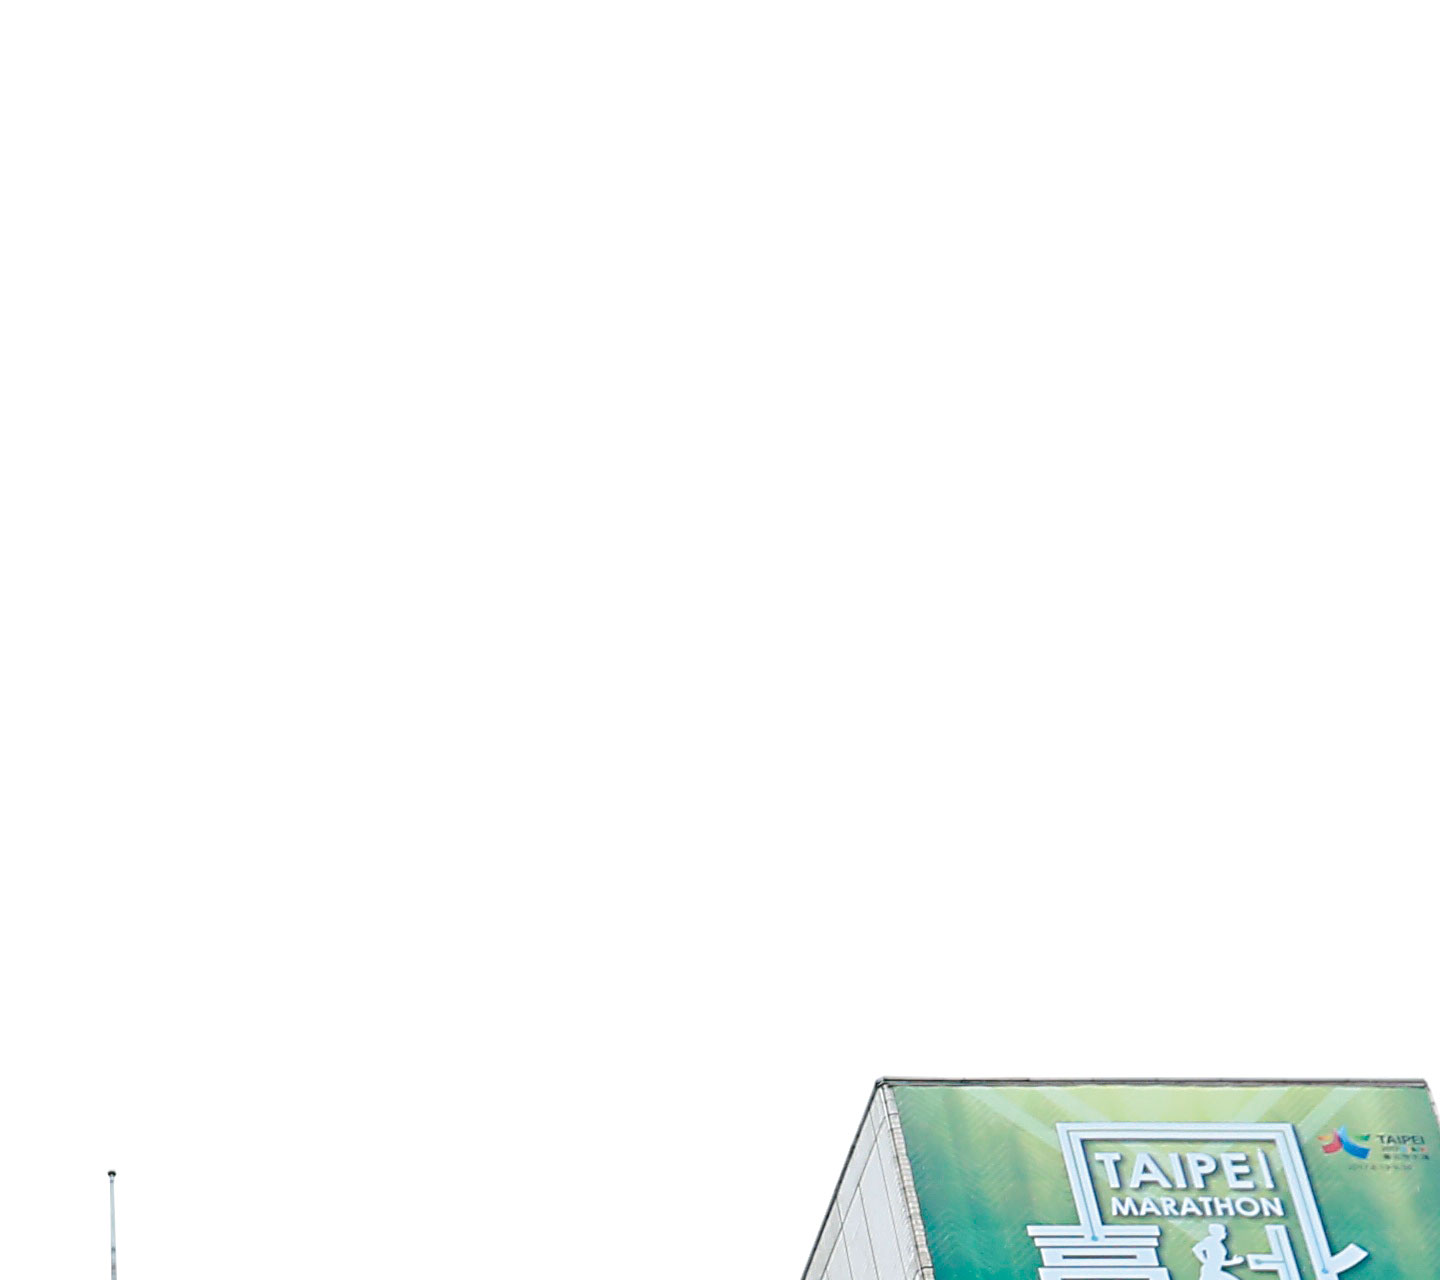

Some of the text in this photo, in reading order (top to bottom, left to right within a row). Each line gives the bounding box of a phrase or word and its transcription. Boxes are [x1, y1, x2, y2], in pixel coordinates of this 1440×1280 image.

[1377, 1135, 1425, 1144] TAIPEI
[1094, 1147, 1276, 1192] TAIPEI
[1110, 1195, 1285, 1218] MARATHON
